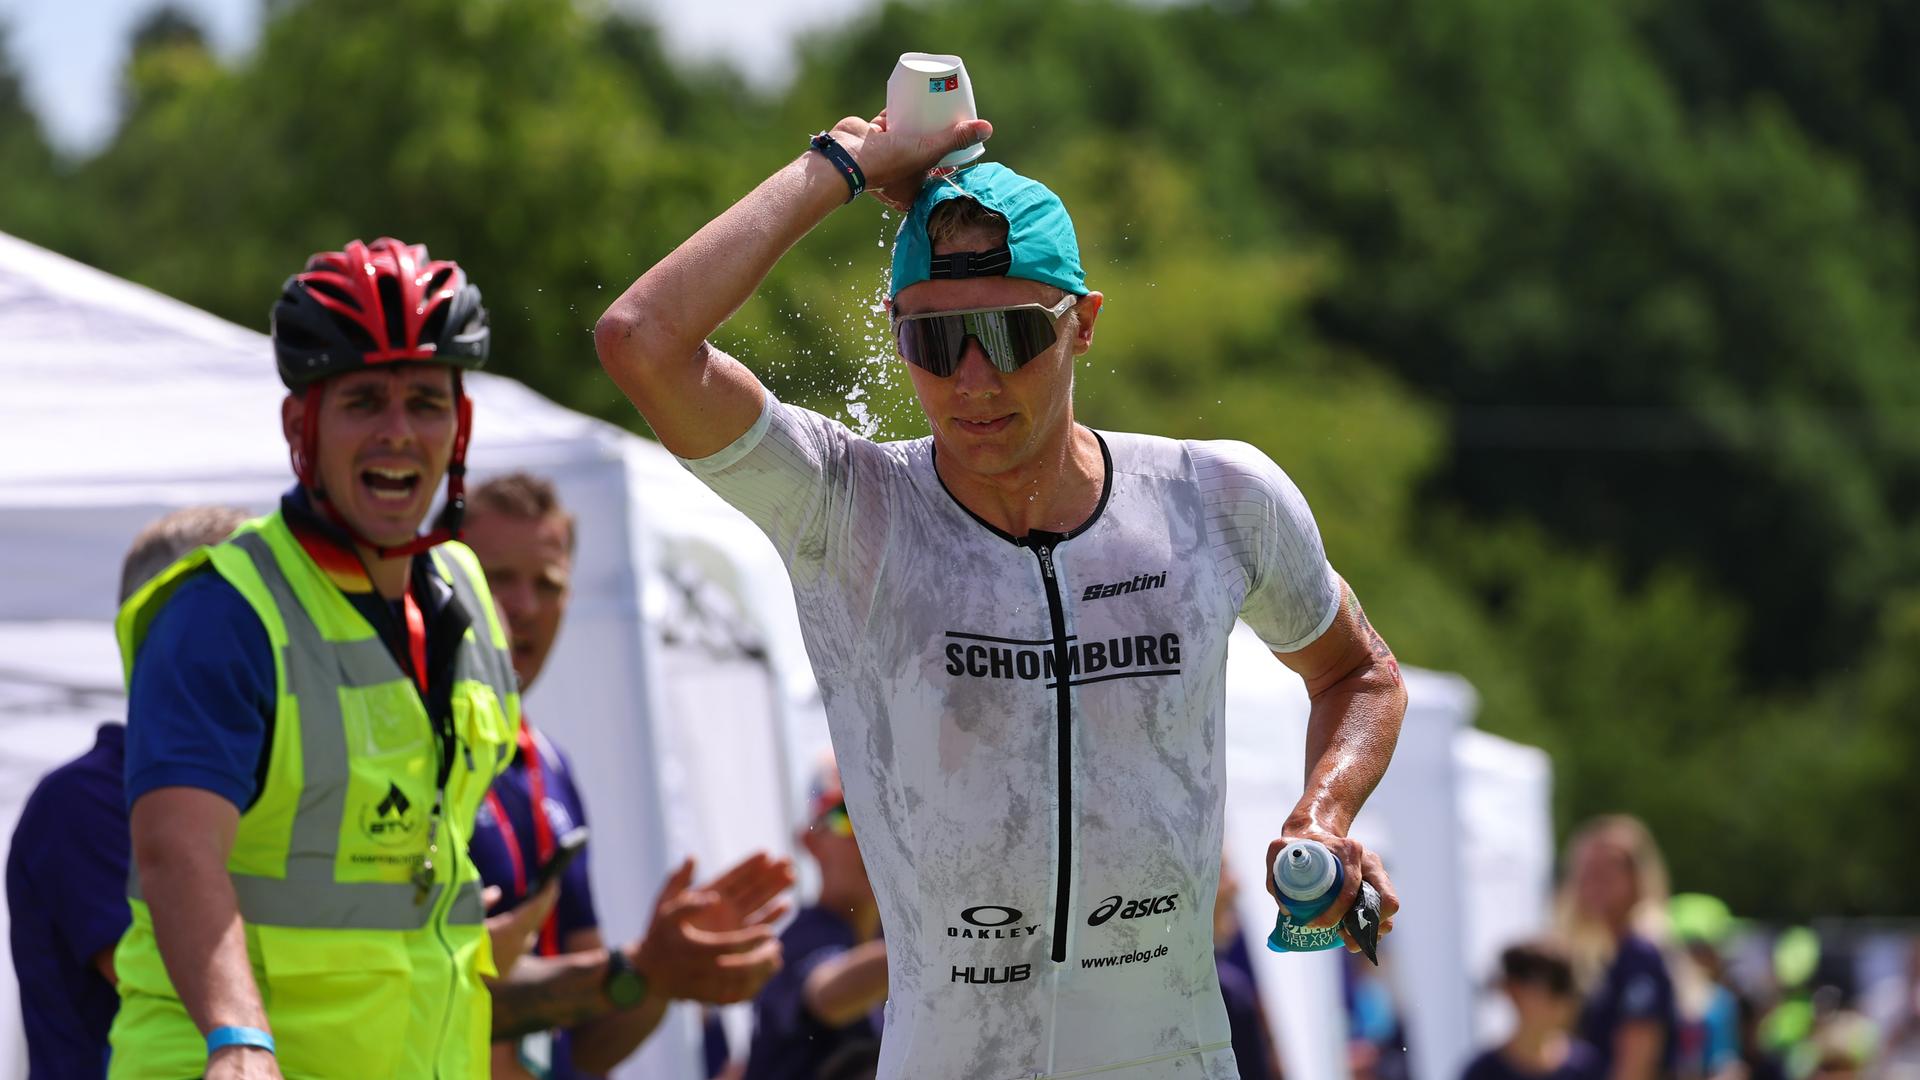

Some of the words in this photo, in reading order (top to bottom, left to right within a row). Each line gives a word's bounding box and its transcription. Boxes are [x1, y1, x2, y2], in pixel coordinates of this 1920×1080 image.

[1082, 571, 1167, 601] Santini
[945, 632, 1181, 680] SCHOMBURG
[947, 924, 1038, 939] OAKLEY
[1081, 944, 1168, 969] www.relog.de
[951, 963, 1032, 984] HUUB
